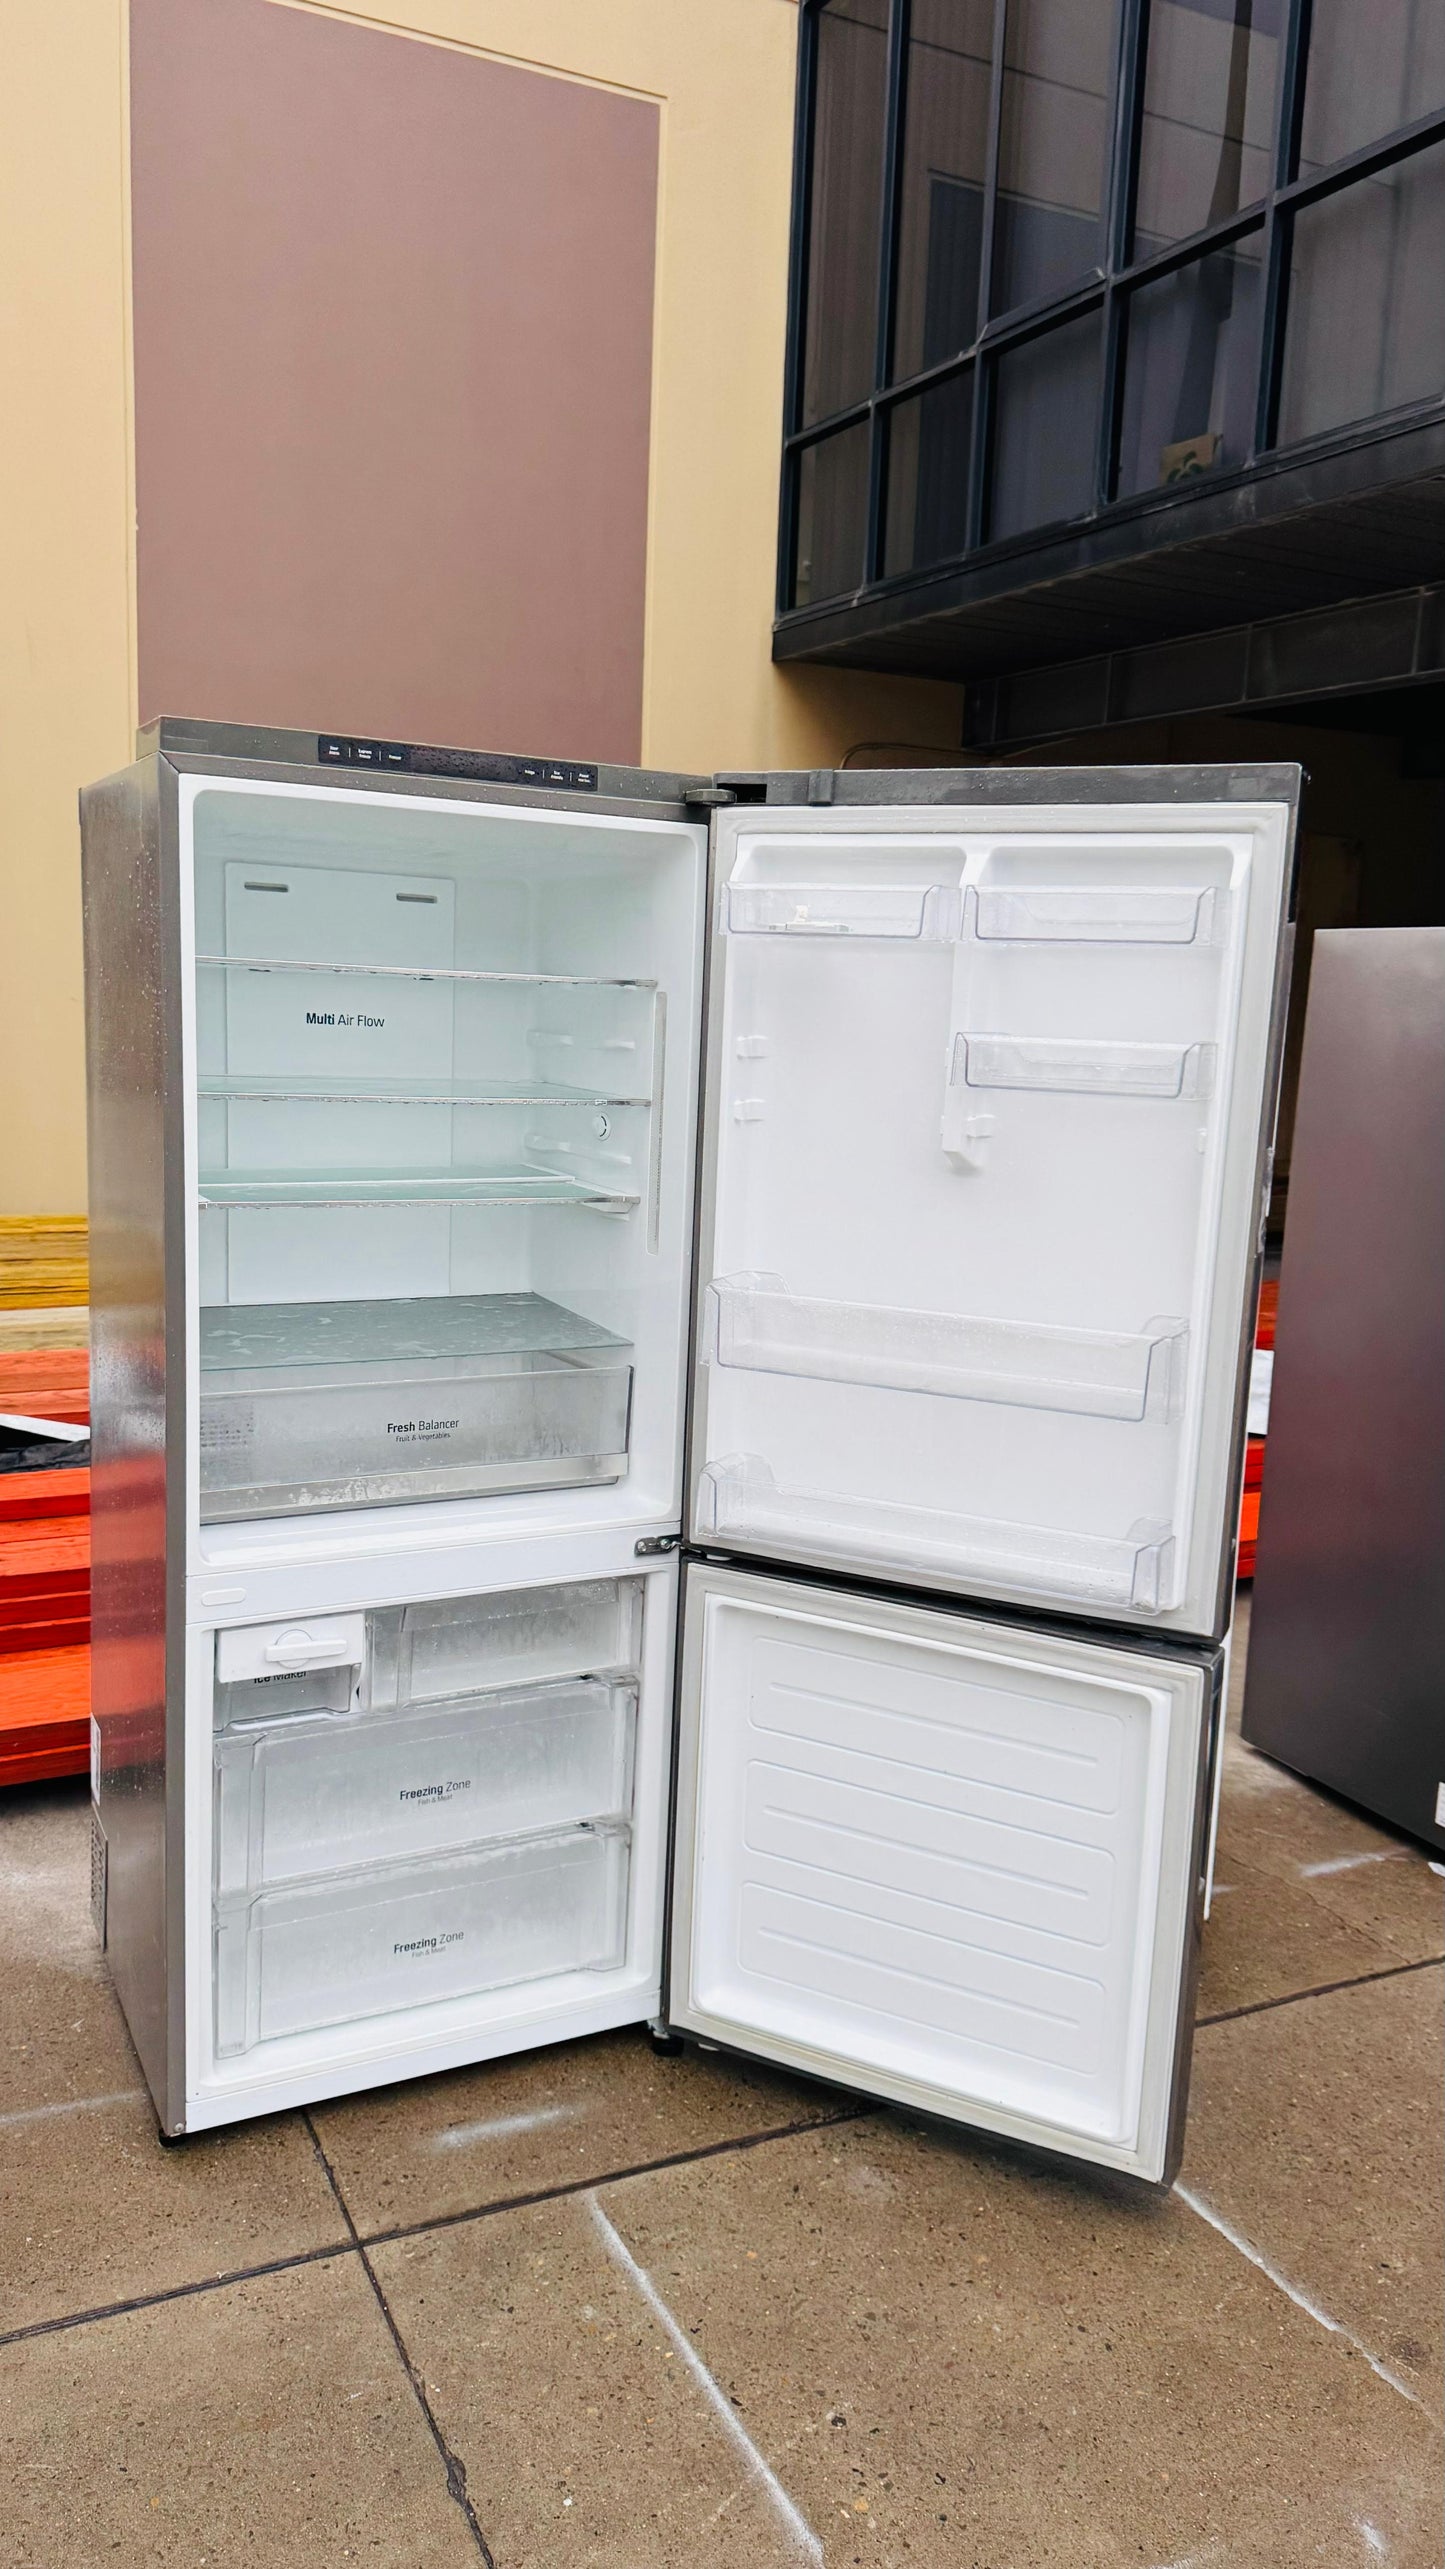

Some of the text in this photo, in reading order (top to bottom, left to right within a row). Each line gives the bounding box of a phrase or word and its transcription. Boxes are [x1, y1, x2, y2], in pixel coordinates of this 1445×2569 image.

[306, 1012, 385, 1027] Multi Air Flow
[387, 1419, 459, 1433] Fresh Balancer
[419, 1431, 451, 1441] Vegetables
[399, 1780, 471, 1800] Freezing Zone
[393, 1931, 464, 1954] Freezing Zone
